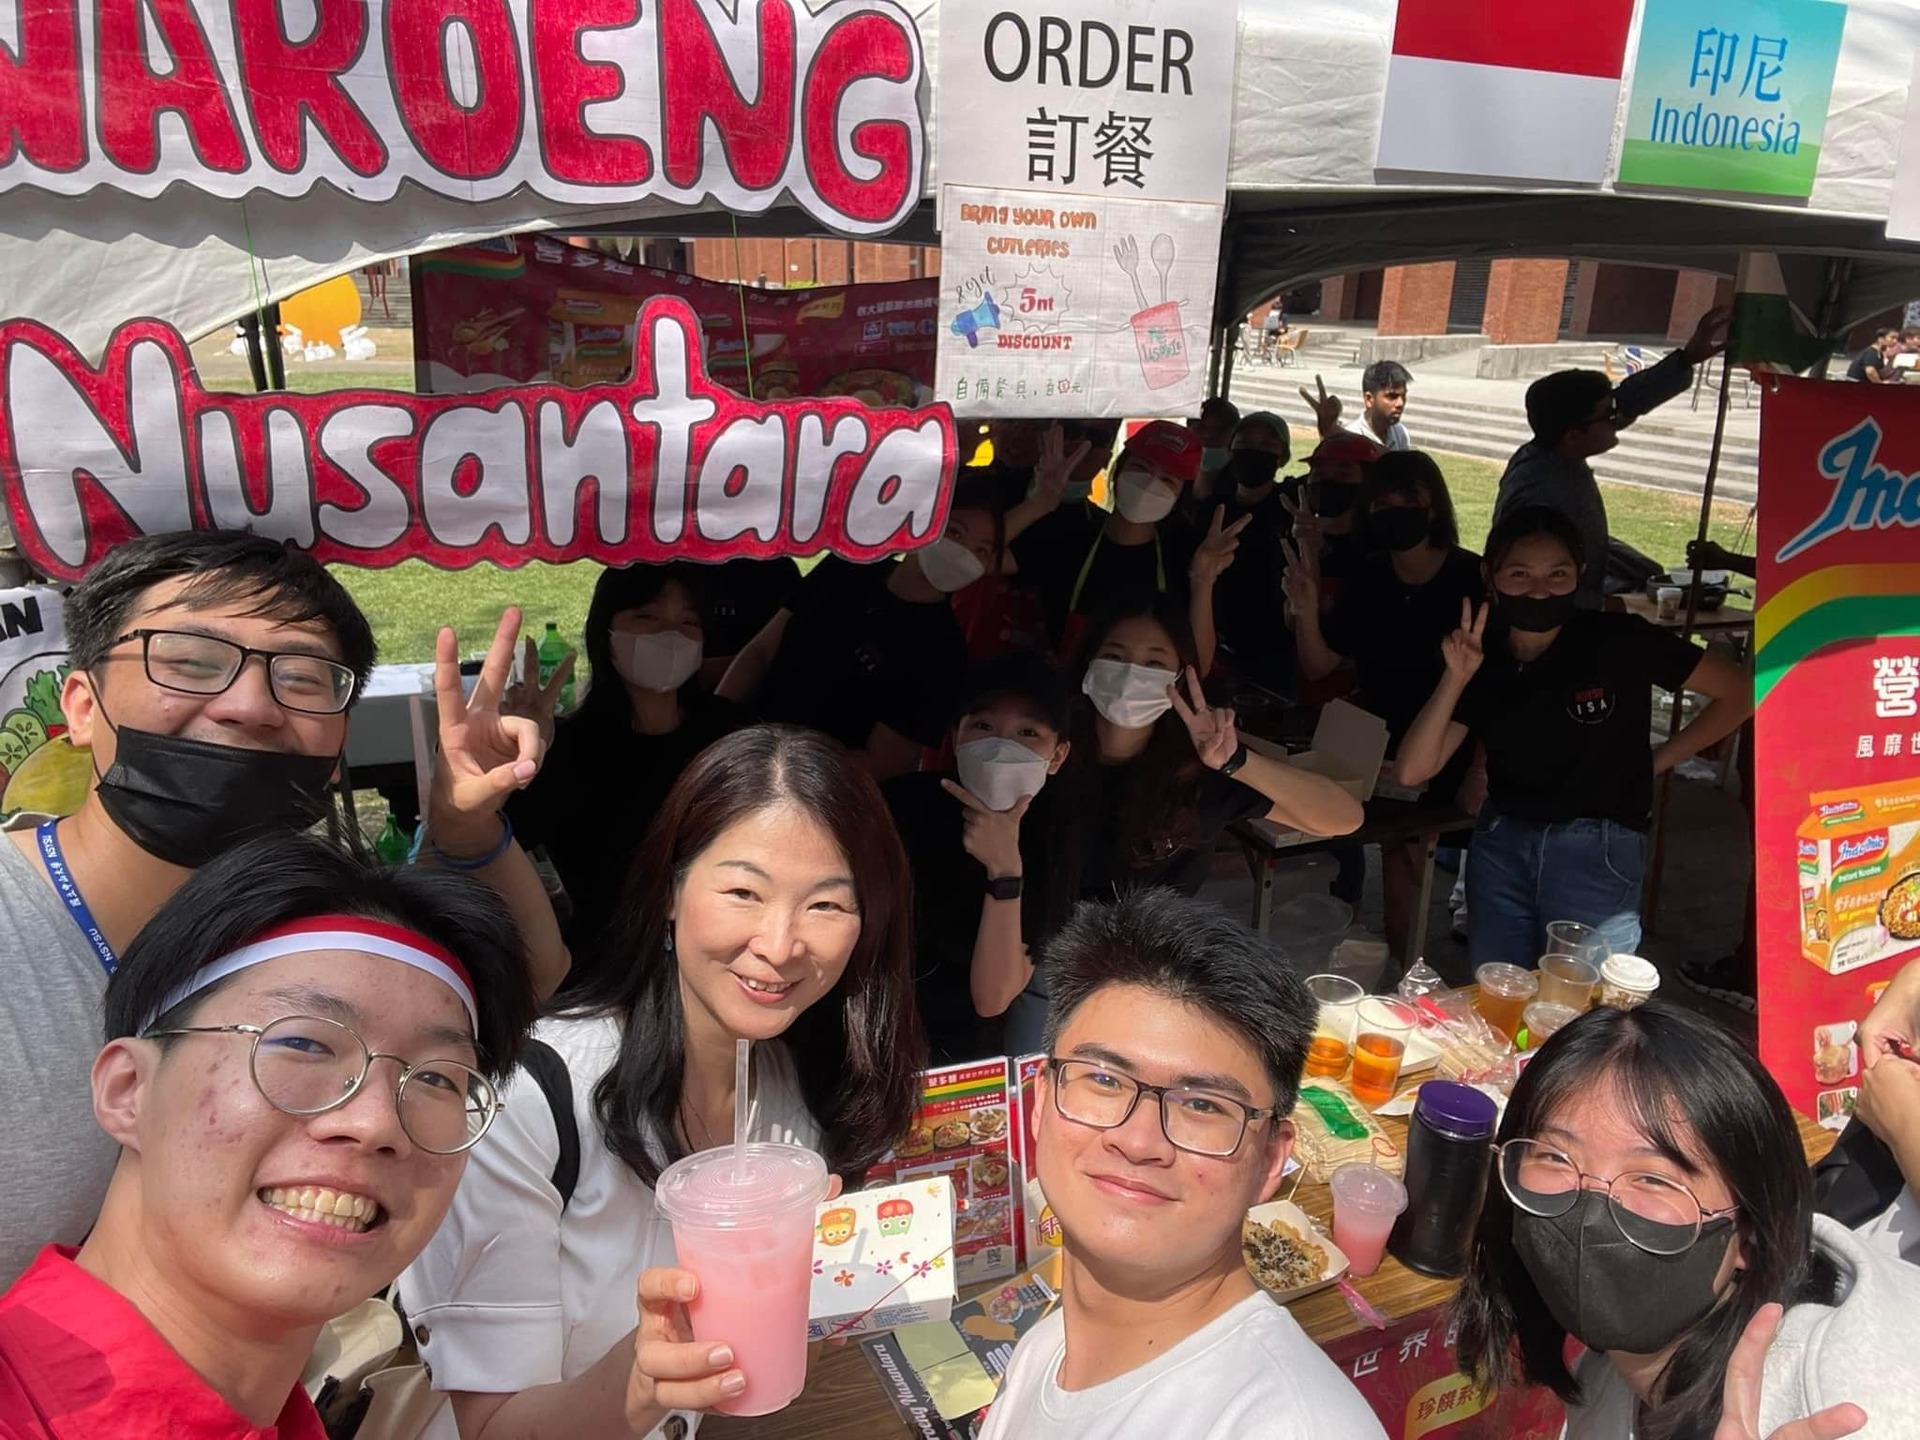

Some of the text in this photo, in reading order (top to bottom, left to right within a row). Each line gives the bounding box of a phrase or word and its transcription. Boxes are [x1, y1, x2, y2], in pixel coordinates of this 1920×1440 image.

[983, 11, 1195, 96] ORDER
[1688, 26, 1788, 102] 印尼
[1026, 106, 1154, 189] 訂餐
[1650, 97, 1801, 156] Indonesia
[997, 334, 1072, 350] DISCOUNT
[5, 315, 946, 568] Nusantara
[0, 595, 44, 642] N
[1576, 698, 1608, 716] ISA
[1872, 655, 1920, 718] 營
[88, 927, 114, 962] NSYSU
[1415, 1384, 1480, 1421] 珍饌系
